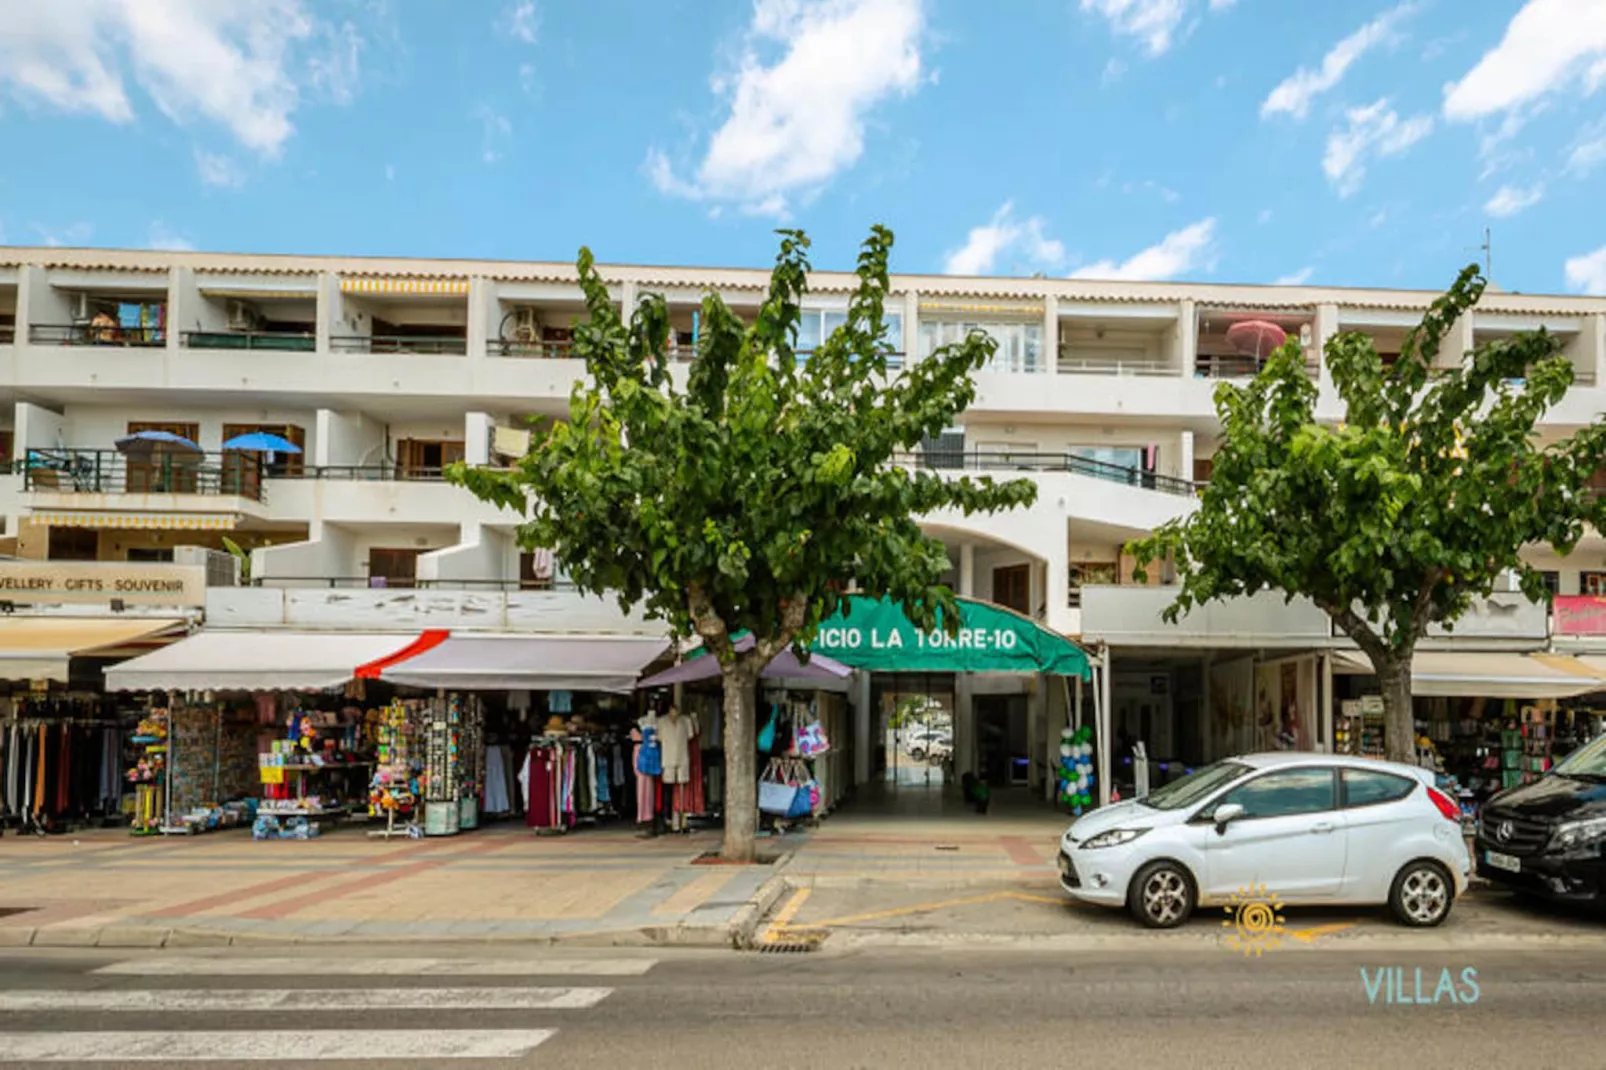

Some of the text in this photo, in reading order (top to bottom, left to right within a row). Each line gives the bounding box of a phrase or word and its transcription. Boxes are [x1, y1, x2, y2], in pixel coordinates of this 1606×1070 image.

[64, 578, 103, 591] GIFTS
[115, 579, 184, 592] SOUVENIR
[812, 627, 1016, 649] ICIO LA TORRE-10
